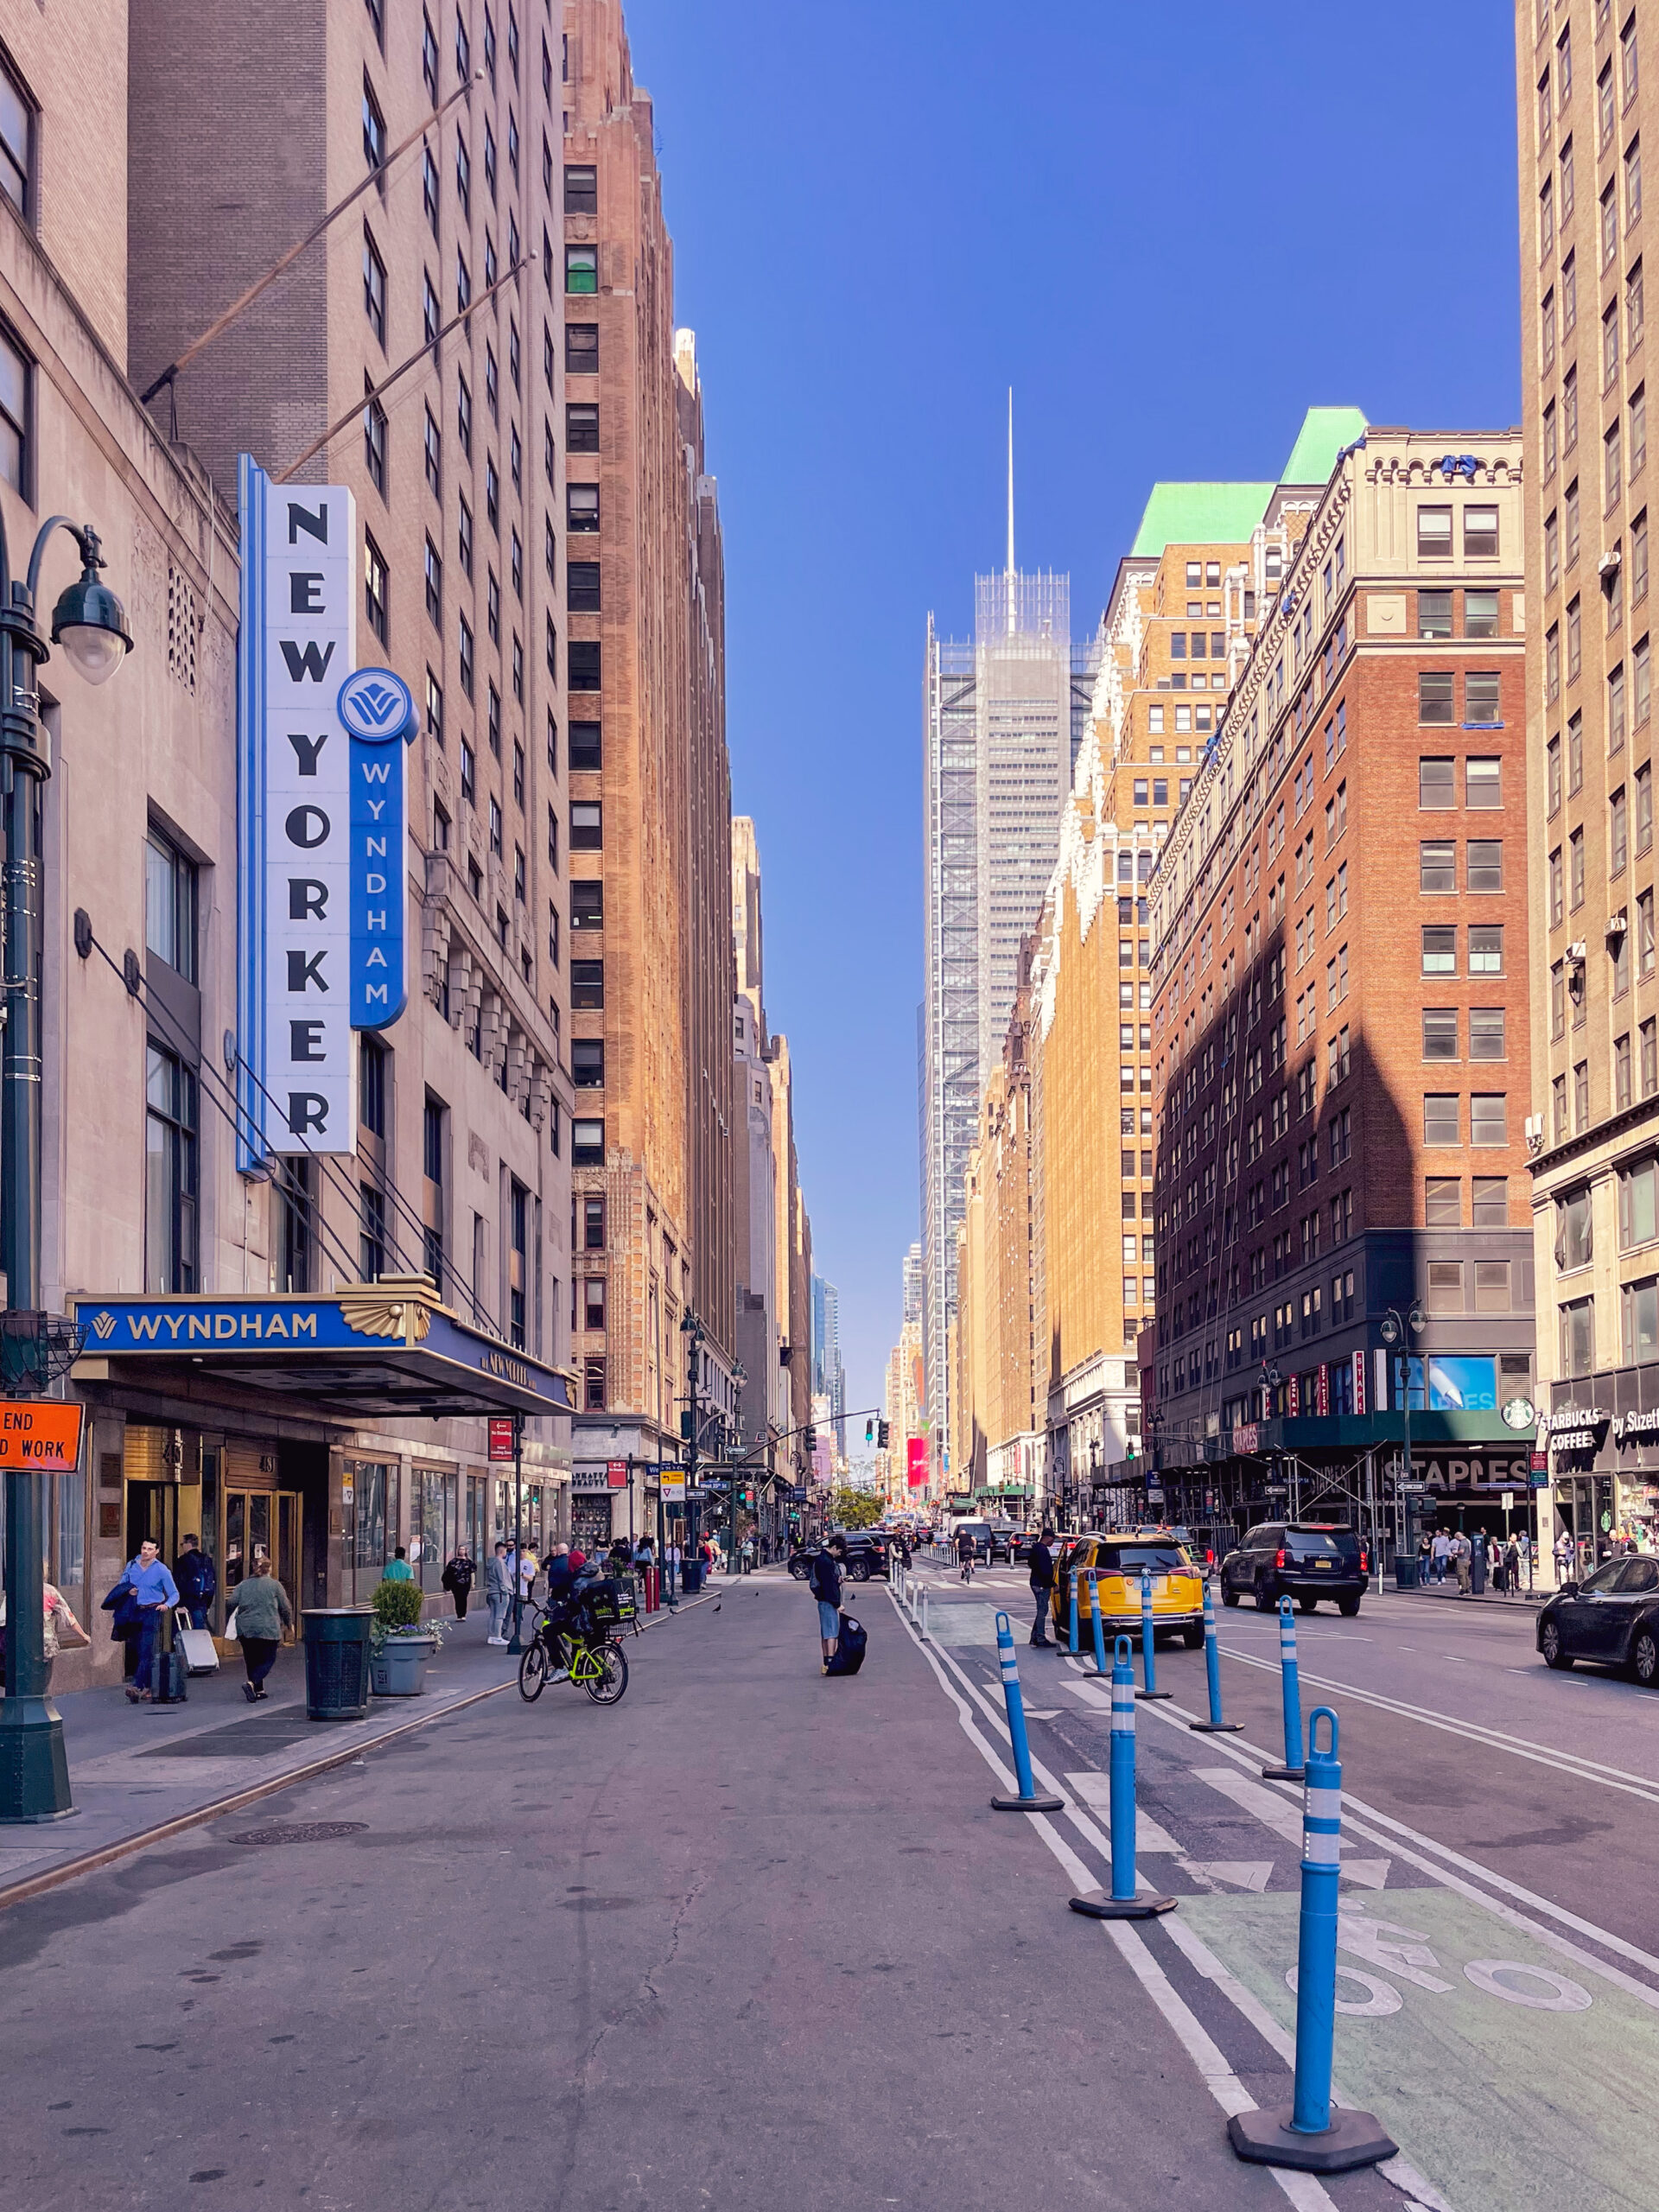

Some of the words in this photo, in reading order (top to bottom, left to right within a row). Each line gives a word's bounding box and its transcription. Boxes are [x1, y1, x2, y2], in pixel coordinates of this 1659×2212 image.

[279, 503, 336, 683] NEW
[362, 763, 391, 1005] WYNDHAM
[285, 734, 331, 1135] YORKER
[126, 1313, 318, 1340] WYNDHAM
[3, 1412, 34, 1431] END
[1540, 1408, 1602, 1432] STARBUCKS
[1611, 1414, 1624, 1439] by
[22, 1440, 65, 1459] WORK
[1232, 1426, 1258, 1452] STAPLES
[1550, 1431, 1593, 1452] COFFEE
[1384, 1460, 1528, 1491] STAPLES
